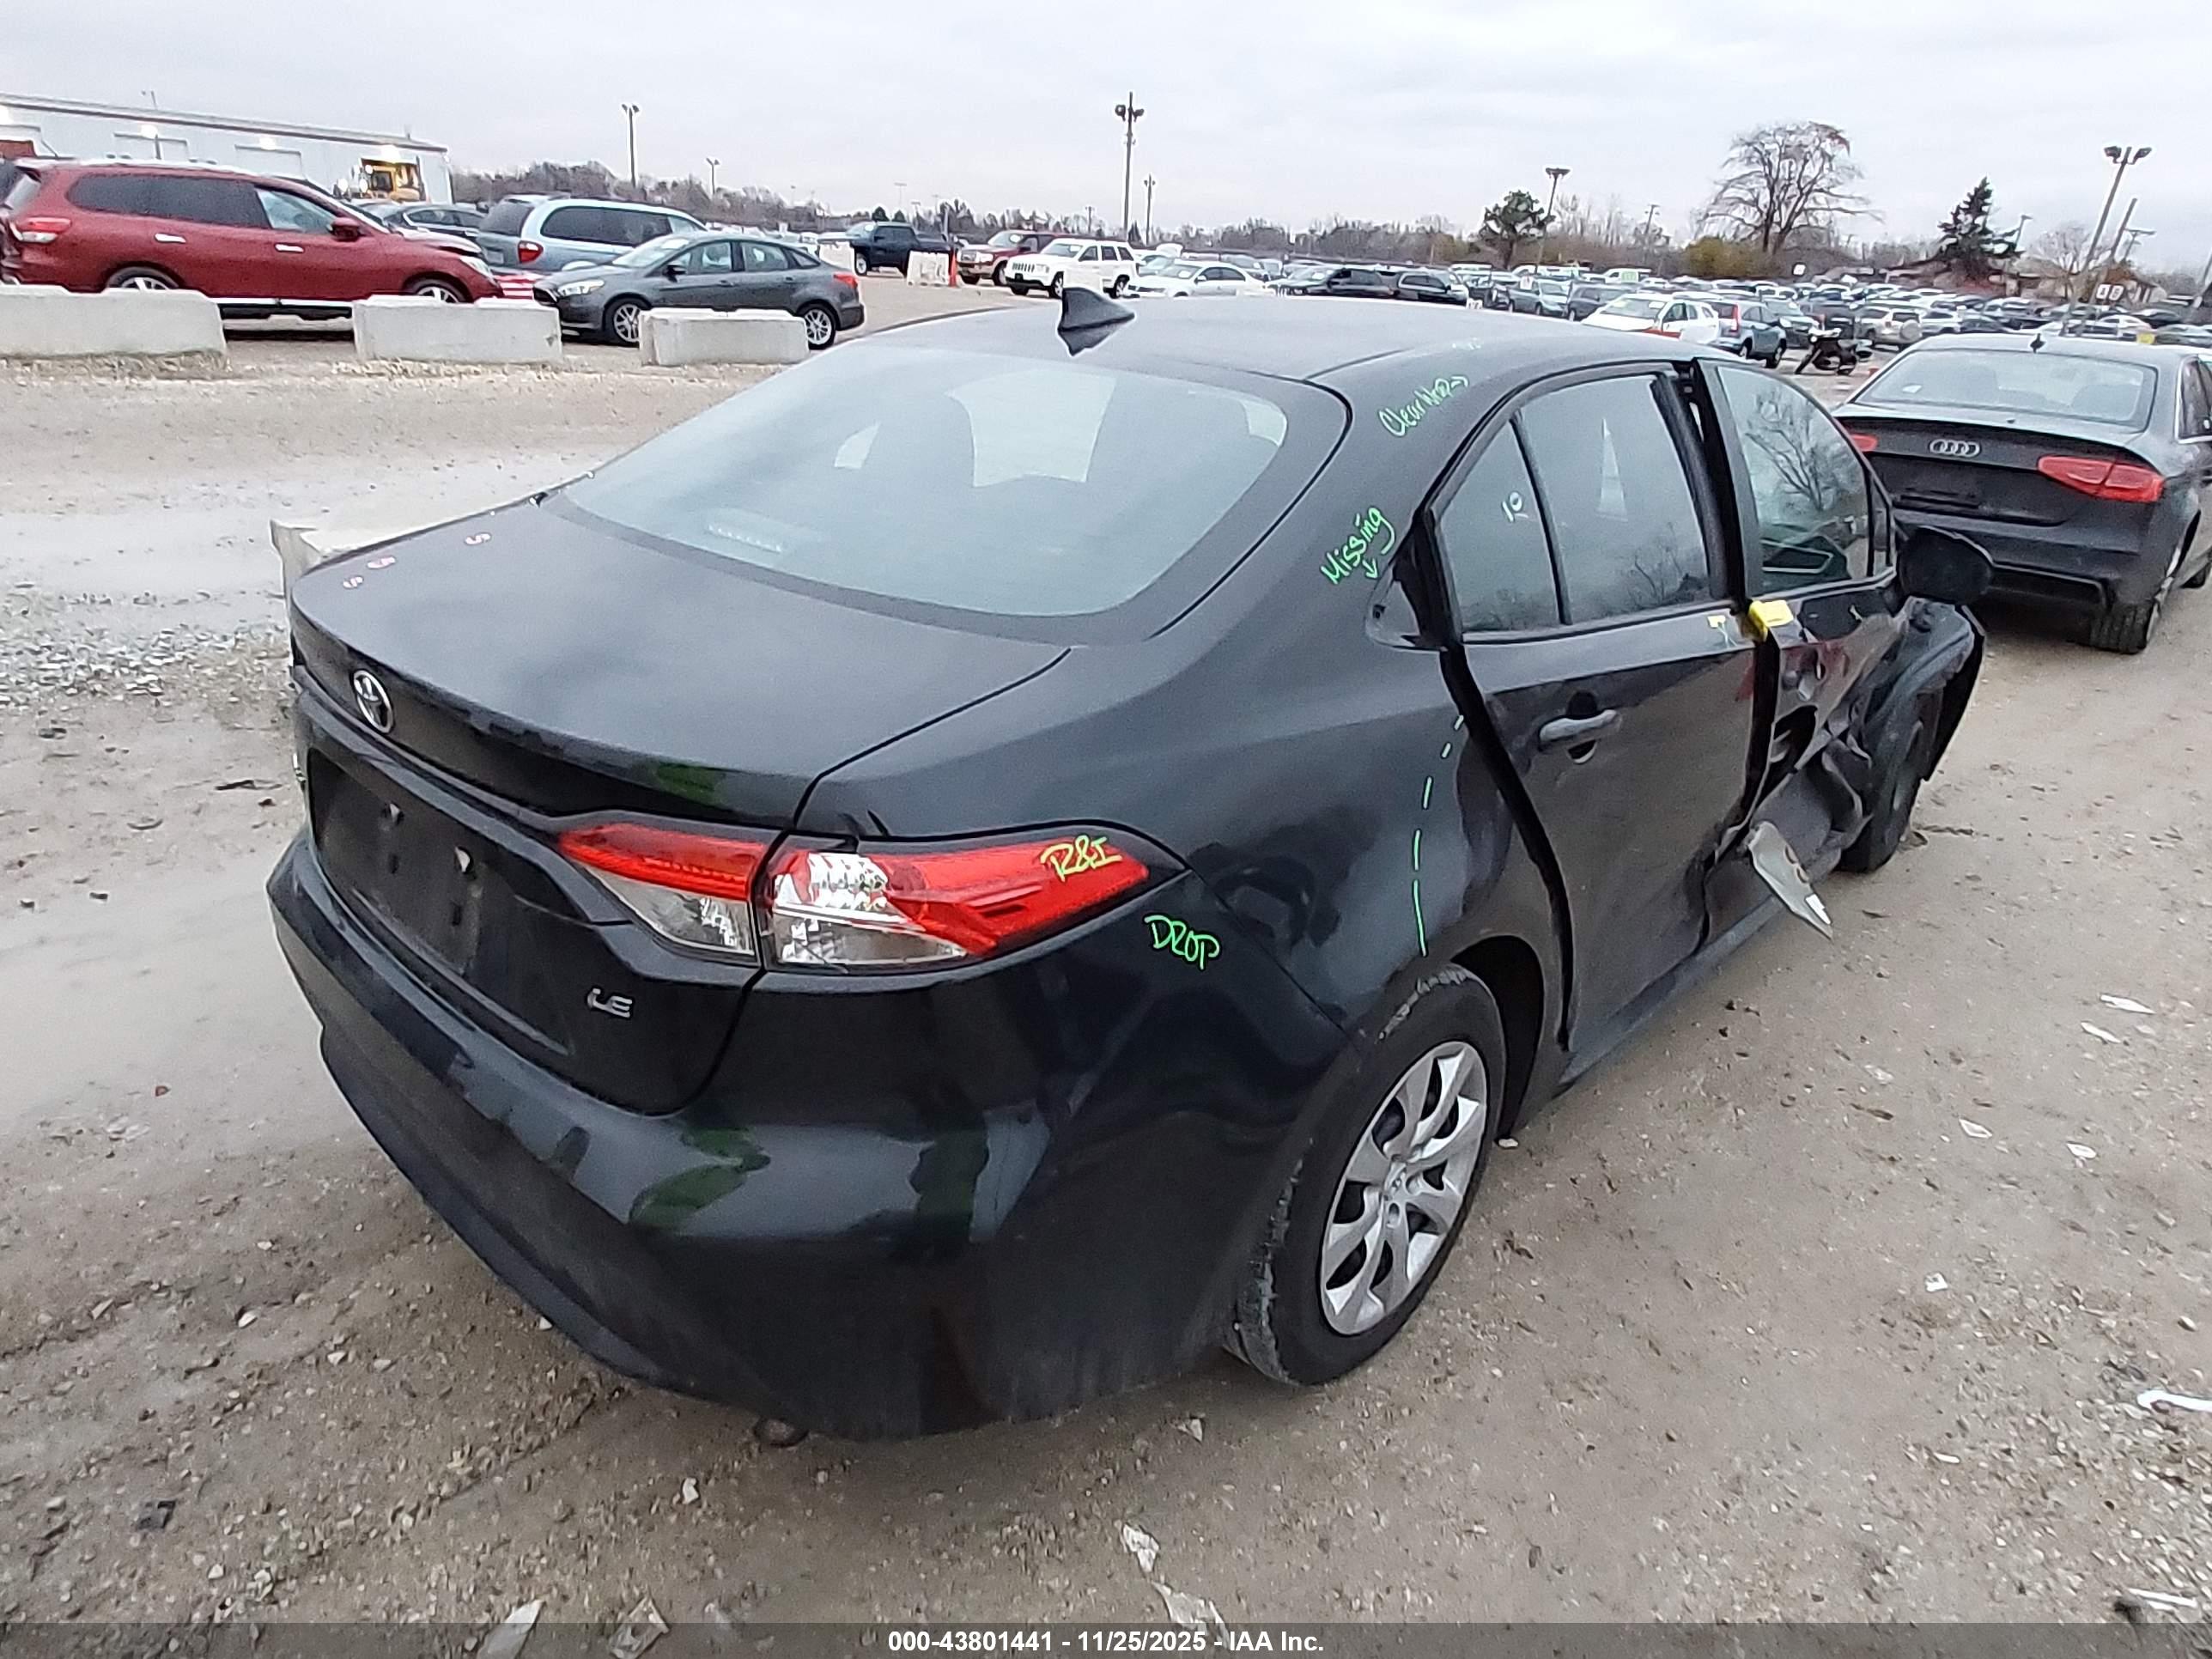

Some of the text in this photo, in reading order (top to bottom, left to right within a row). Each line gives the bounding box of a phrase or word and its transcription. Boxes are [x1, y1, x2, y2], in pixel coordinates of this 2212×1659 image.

[1320, 506, 1396, 585] Missing
[1144, 914, 1220, 970] DROP
[586, 988, 633, 1018] LE
